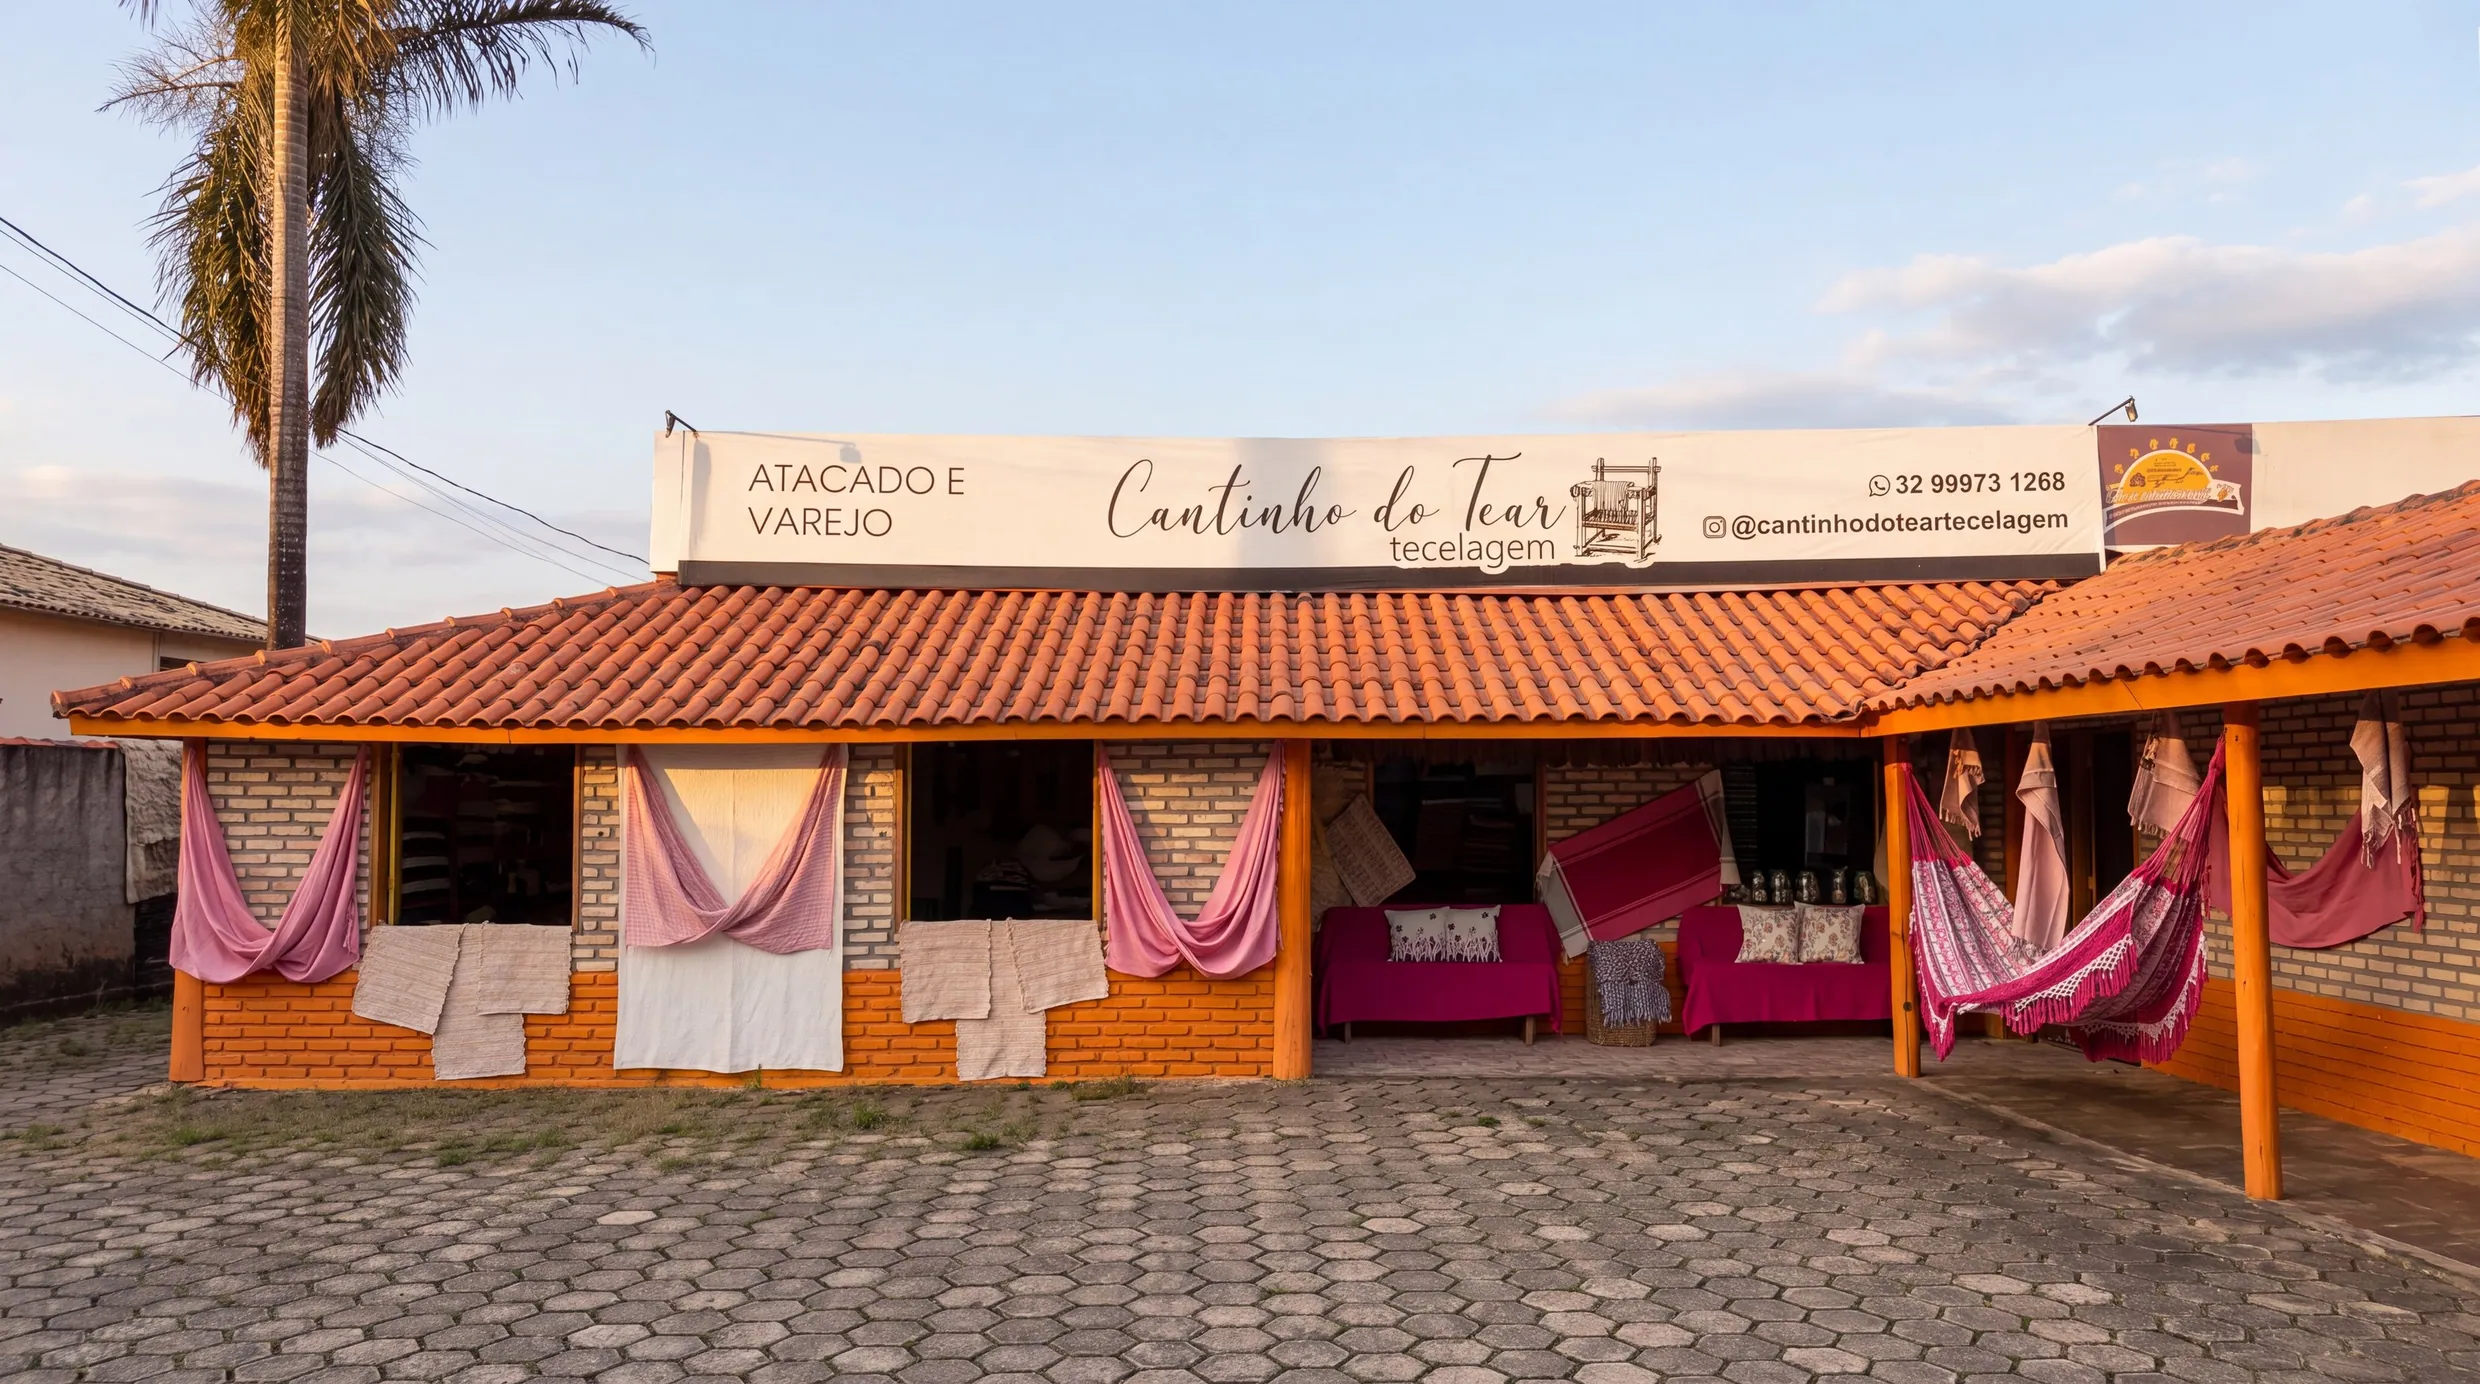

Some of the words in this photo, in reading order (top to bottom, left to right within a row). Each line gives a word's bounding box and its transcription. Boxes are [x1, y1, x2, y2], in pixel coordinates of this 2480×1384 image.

[748, 463, 935, 496] ATACADO
[948, 466, 965, 496] E
[1108, 458, 1356, 538] Cantinho
[1373, 464, 1440, 532] do
[1452, 451, 1567, 532] Tear
[1895, 474, 1923, 495] 32
[1930, 473, 2001, 494] 99973
[2009, 471, 2066, 492] 1268
[748, 507, 893, 538] VAREJO
[1731, 510, 2069, 540] @cantinhodoteartecelagem
[1390, 532, 1556, 568] tecelagem
